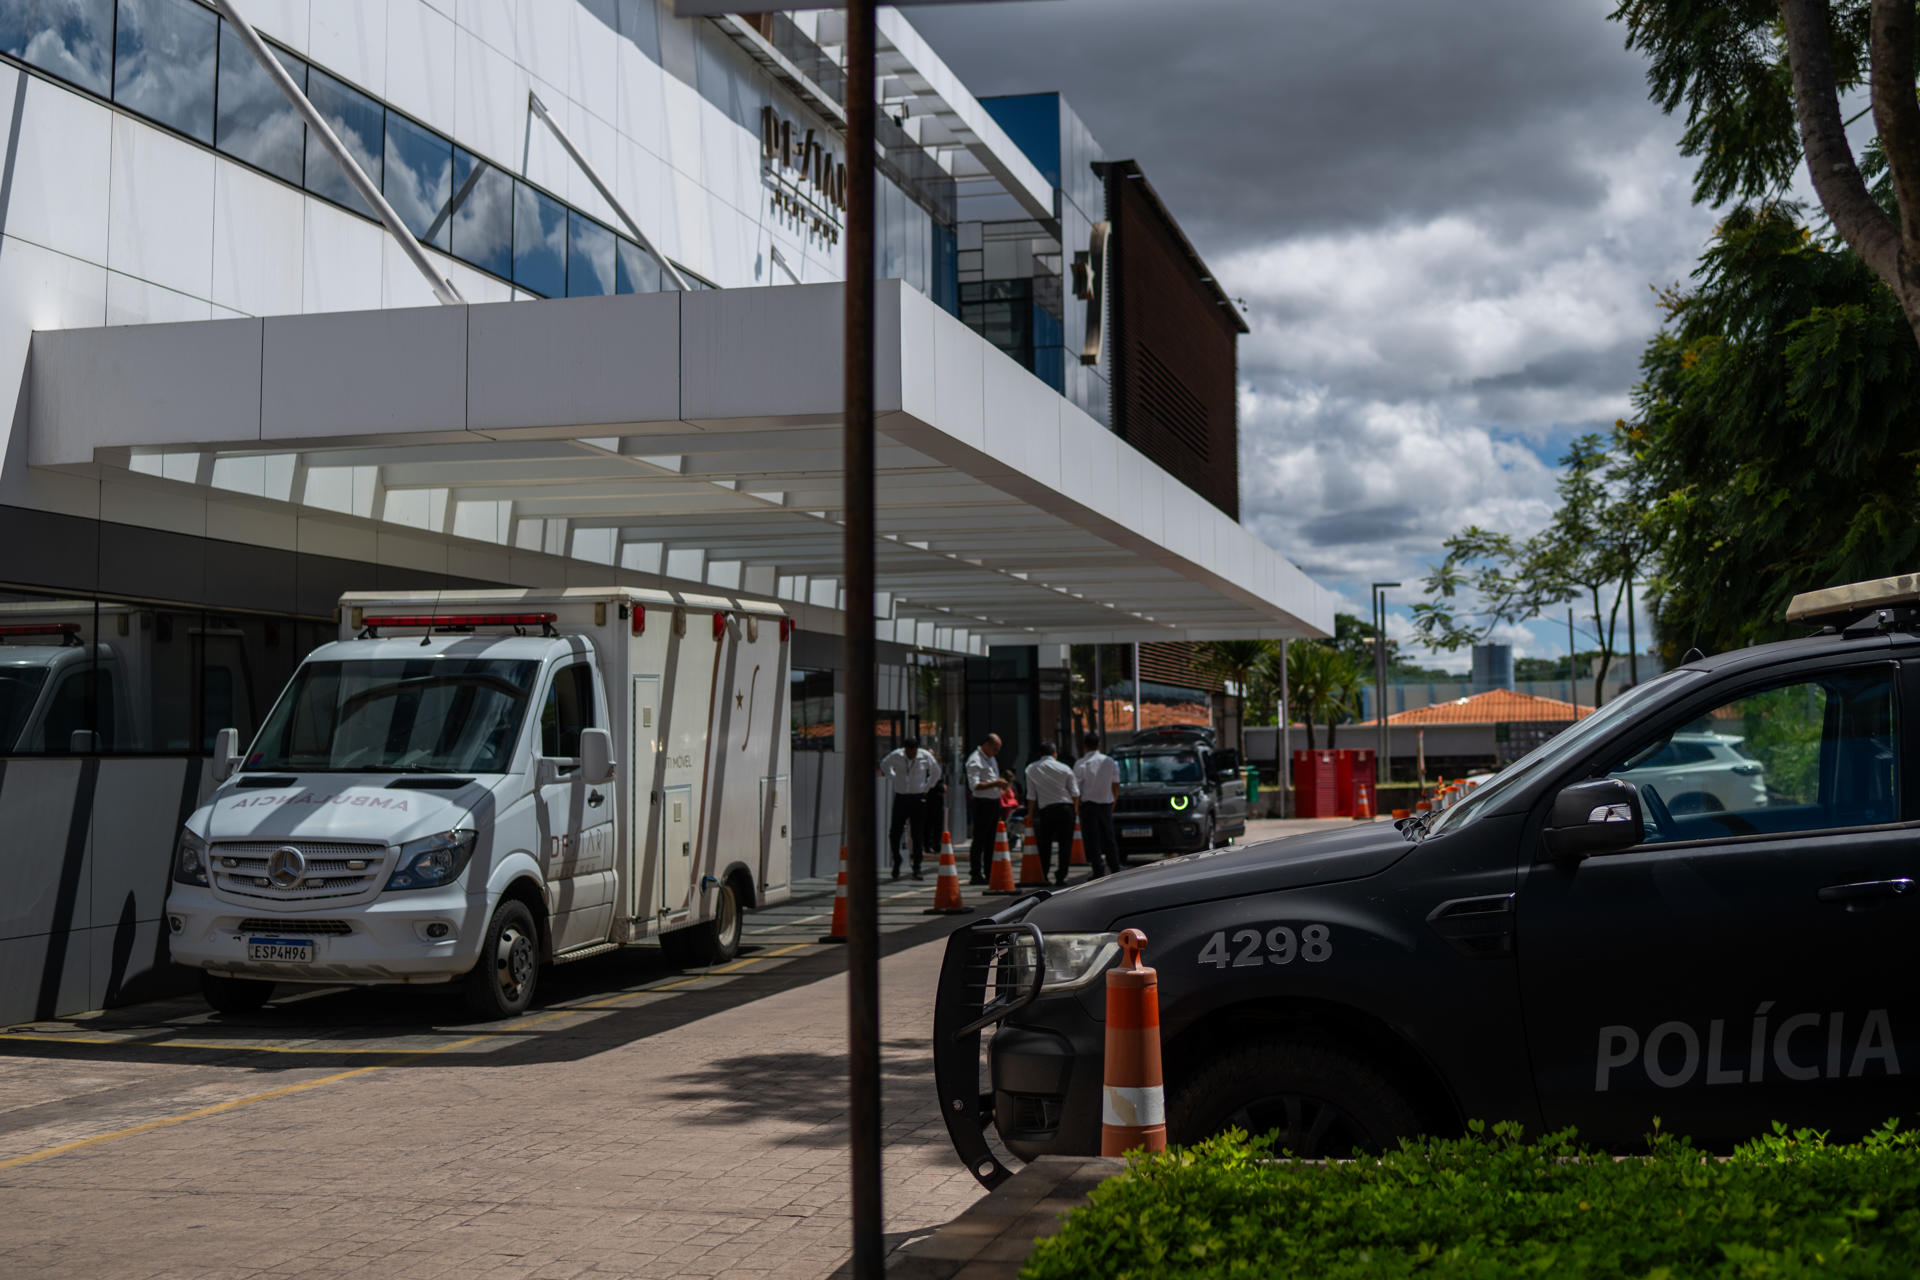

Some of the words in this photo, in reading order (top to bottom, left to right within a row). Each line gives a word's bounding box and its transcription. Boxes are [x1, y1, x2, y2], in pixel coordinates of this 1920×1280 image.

[254, 945, 306, 960] ESP4H96
[1197, 923, 1334, 969] 4298
[1594, 1000, 1904, 1092] POLÍCIA
